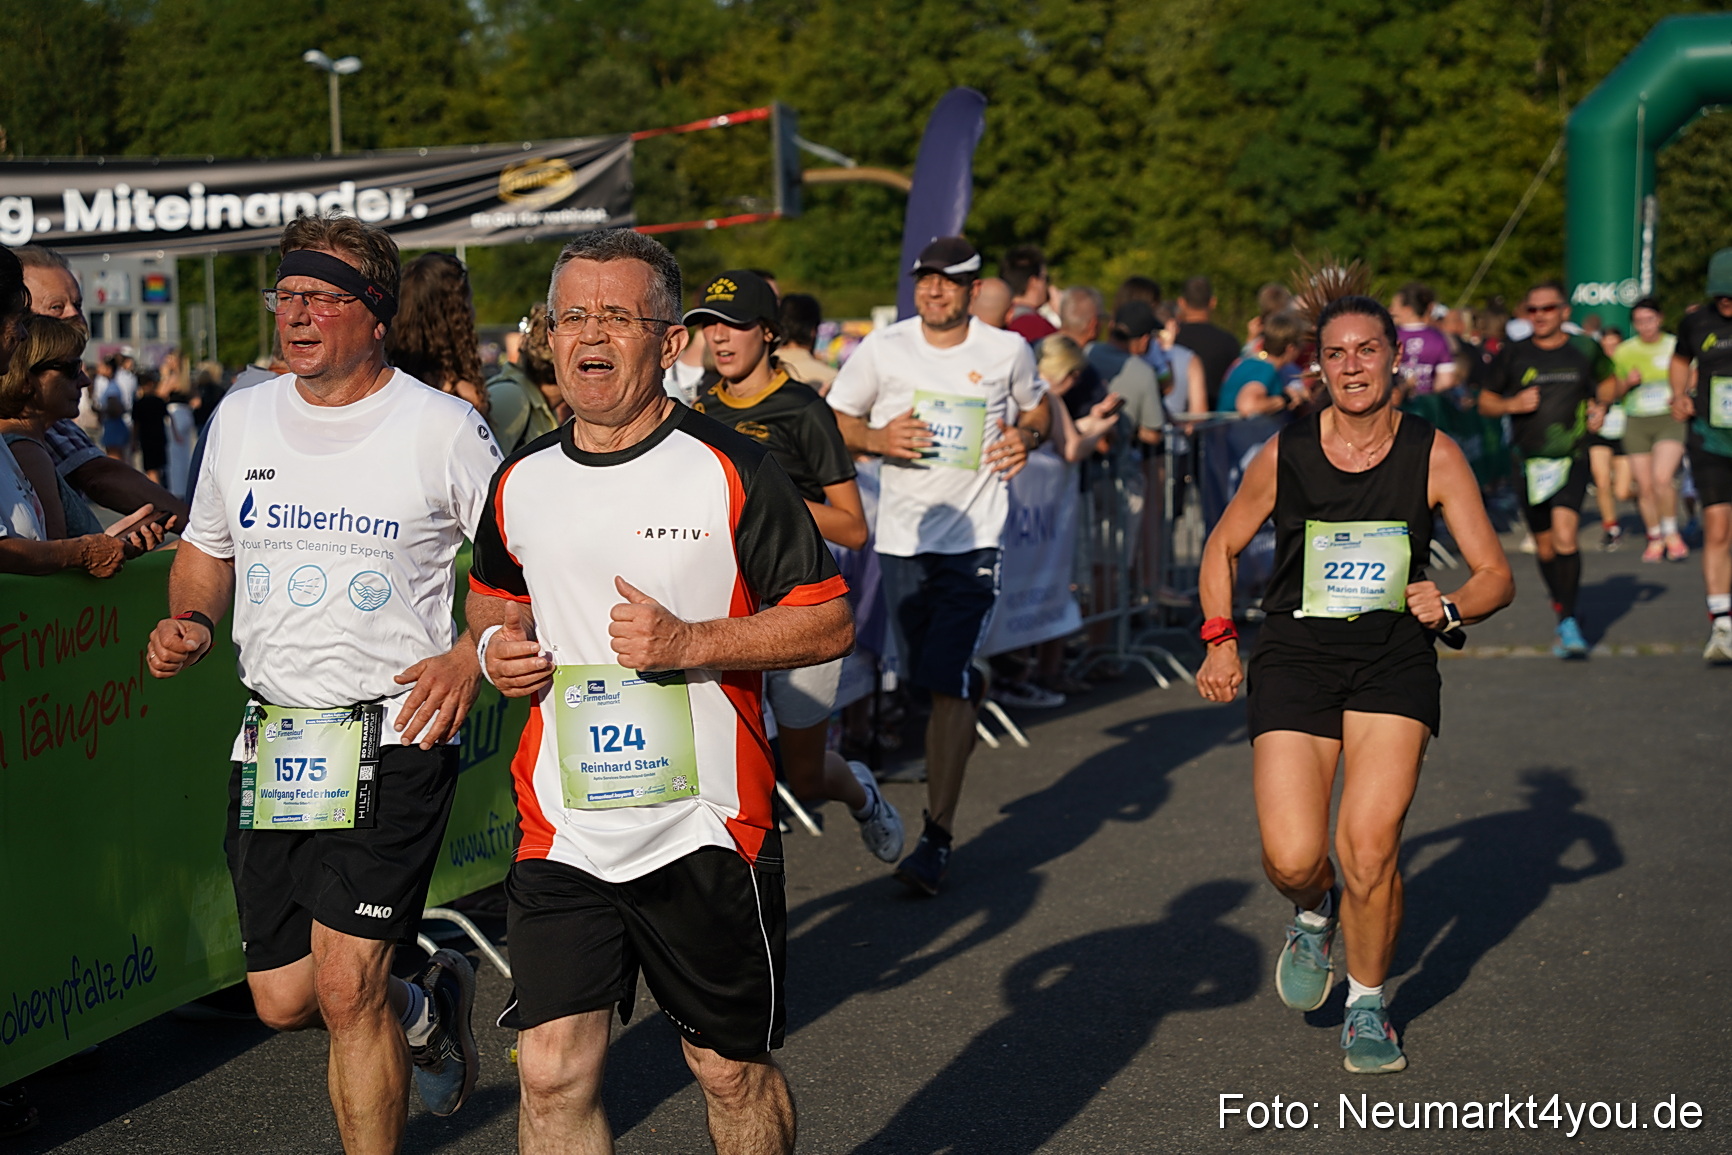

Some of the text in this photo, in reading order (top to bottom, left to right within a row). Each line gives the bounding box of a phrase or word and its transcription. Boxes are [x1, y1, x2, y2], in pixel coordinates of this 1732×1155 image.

[63, 181, 429, 233] Miteinander.
[245, 468, 275, 480] JAKO
[266, 503, 400, 540] Silberhorn
[644, 527, 701, 540] APTIV
[239, 539, 394, 560] Your Parts Cleaning Experts
[1323, 561, 1386, 581] 2272
[1327, 585, 1386, 594] Marion Blank
[19, 649, 148, 760] länger!
[582, 691, 621, 703] Firmenlauf
[362, 712, 370, 743] RABATT
[589, 723, 646, 753] 124
[274, 757, 328, 782] 1575
[580, 756, 670, 773] Reinhard Stark
[260, 788, 350, 800] Wolfgang Federhofer
[358, 784, 368, 819] HILTL
[355, 902, 393, 918] JAKO
